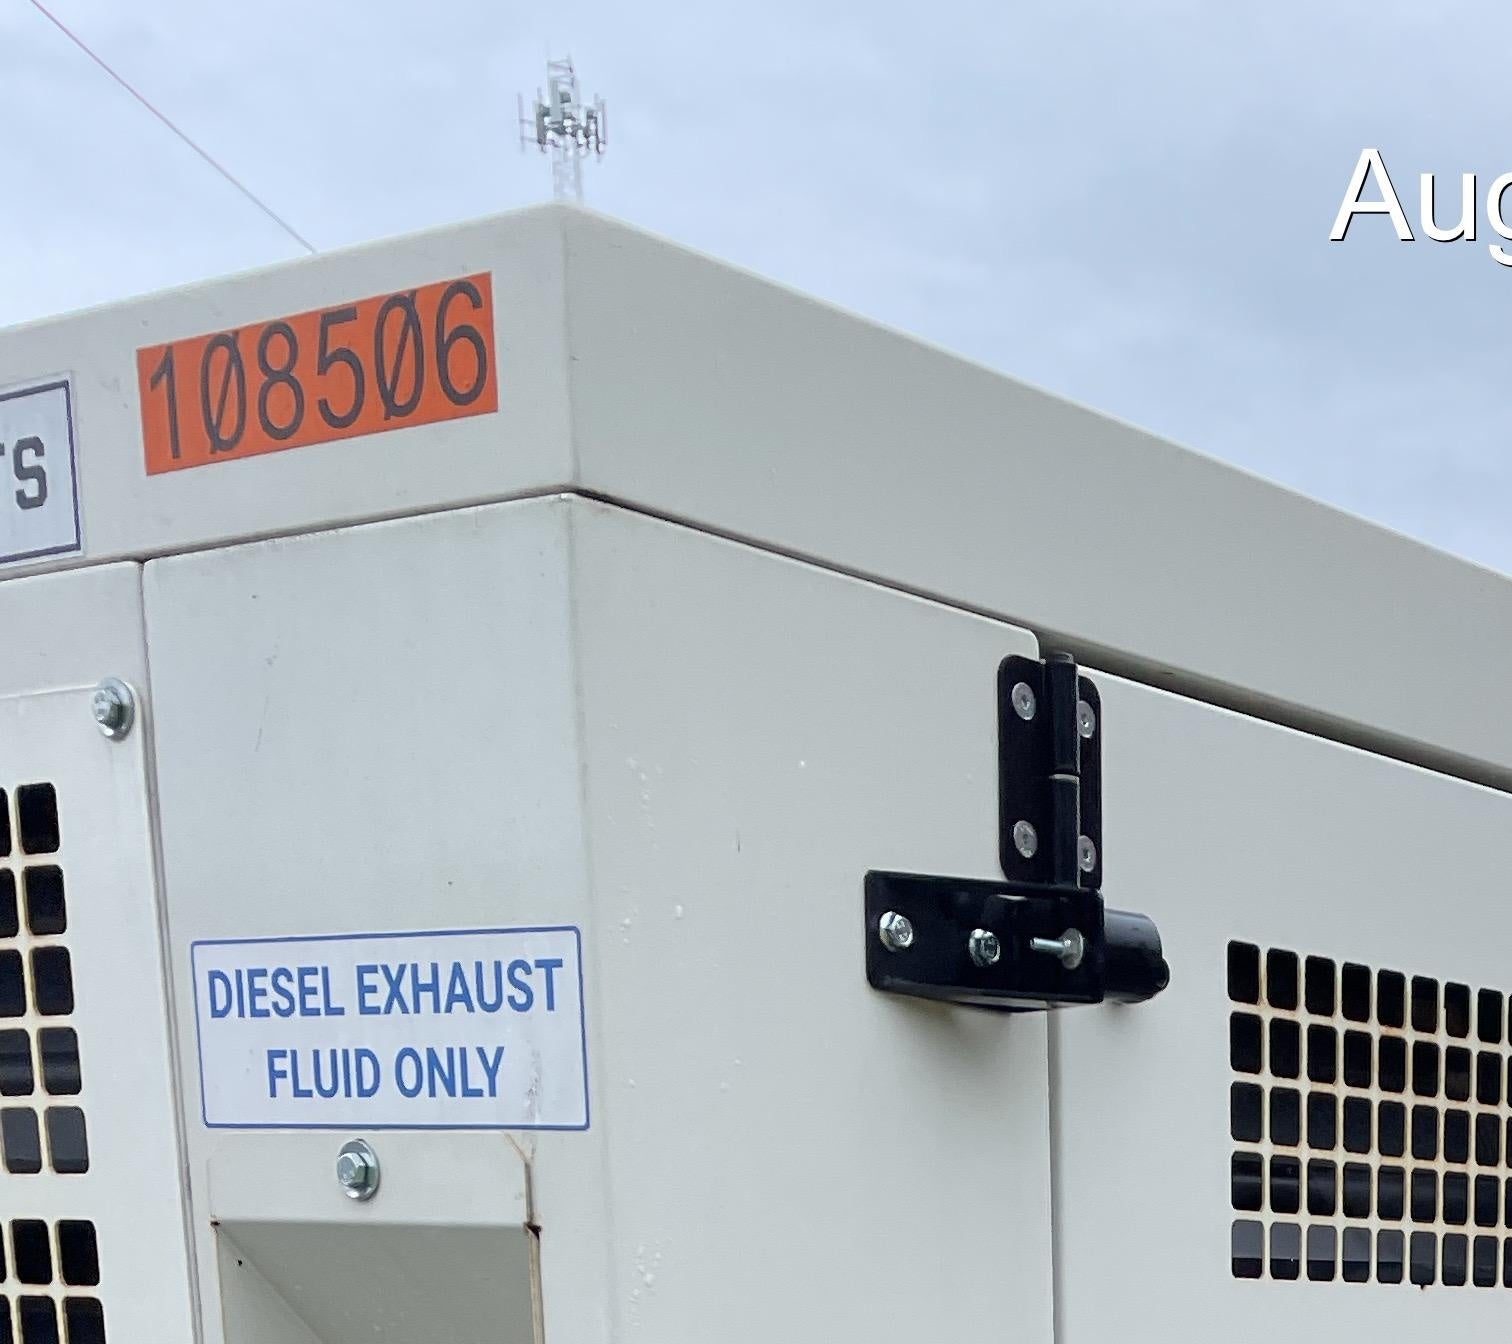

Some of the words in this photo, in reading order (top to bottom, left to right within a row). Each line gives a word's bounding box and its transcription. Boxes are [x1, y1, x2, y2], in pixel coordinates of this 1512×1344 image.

[148, 280, 489, 459] 108506
[0, 435, 48, 510] S
[207, 965, 345, 1019] DIESEL
[356, 958, 563, 1016] EXHAUST
[267, 1047, 381, 1098] FLUID
[395, 1046, 505, 1098] ONLY
